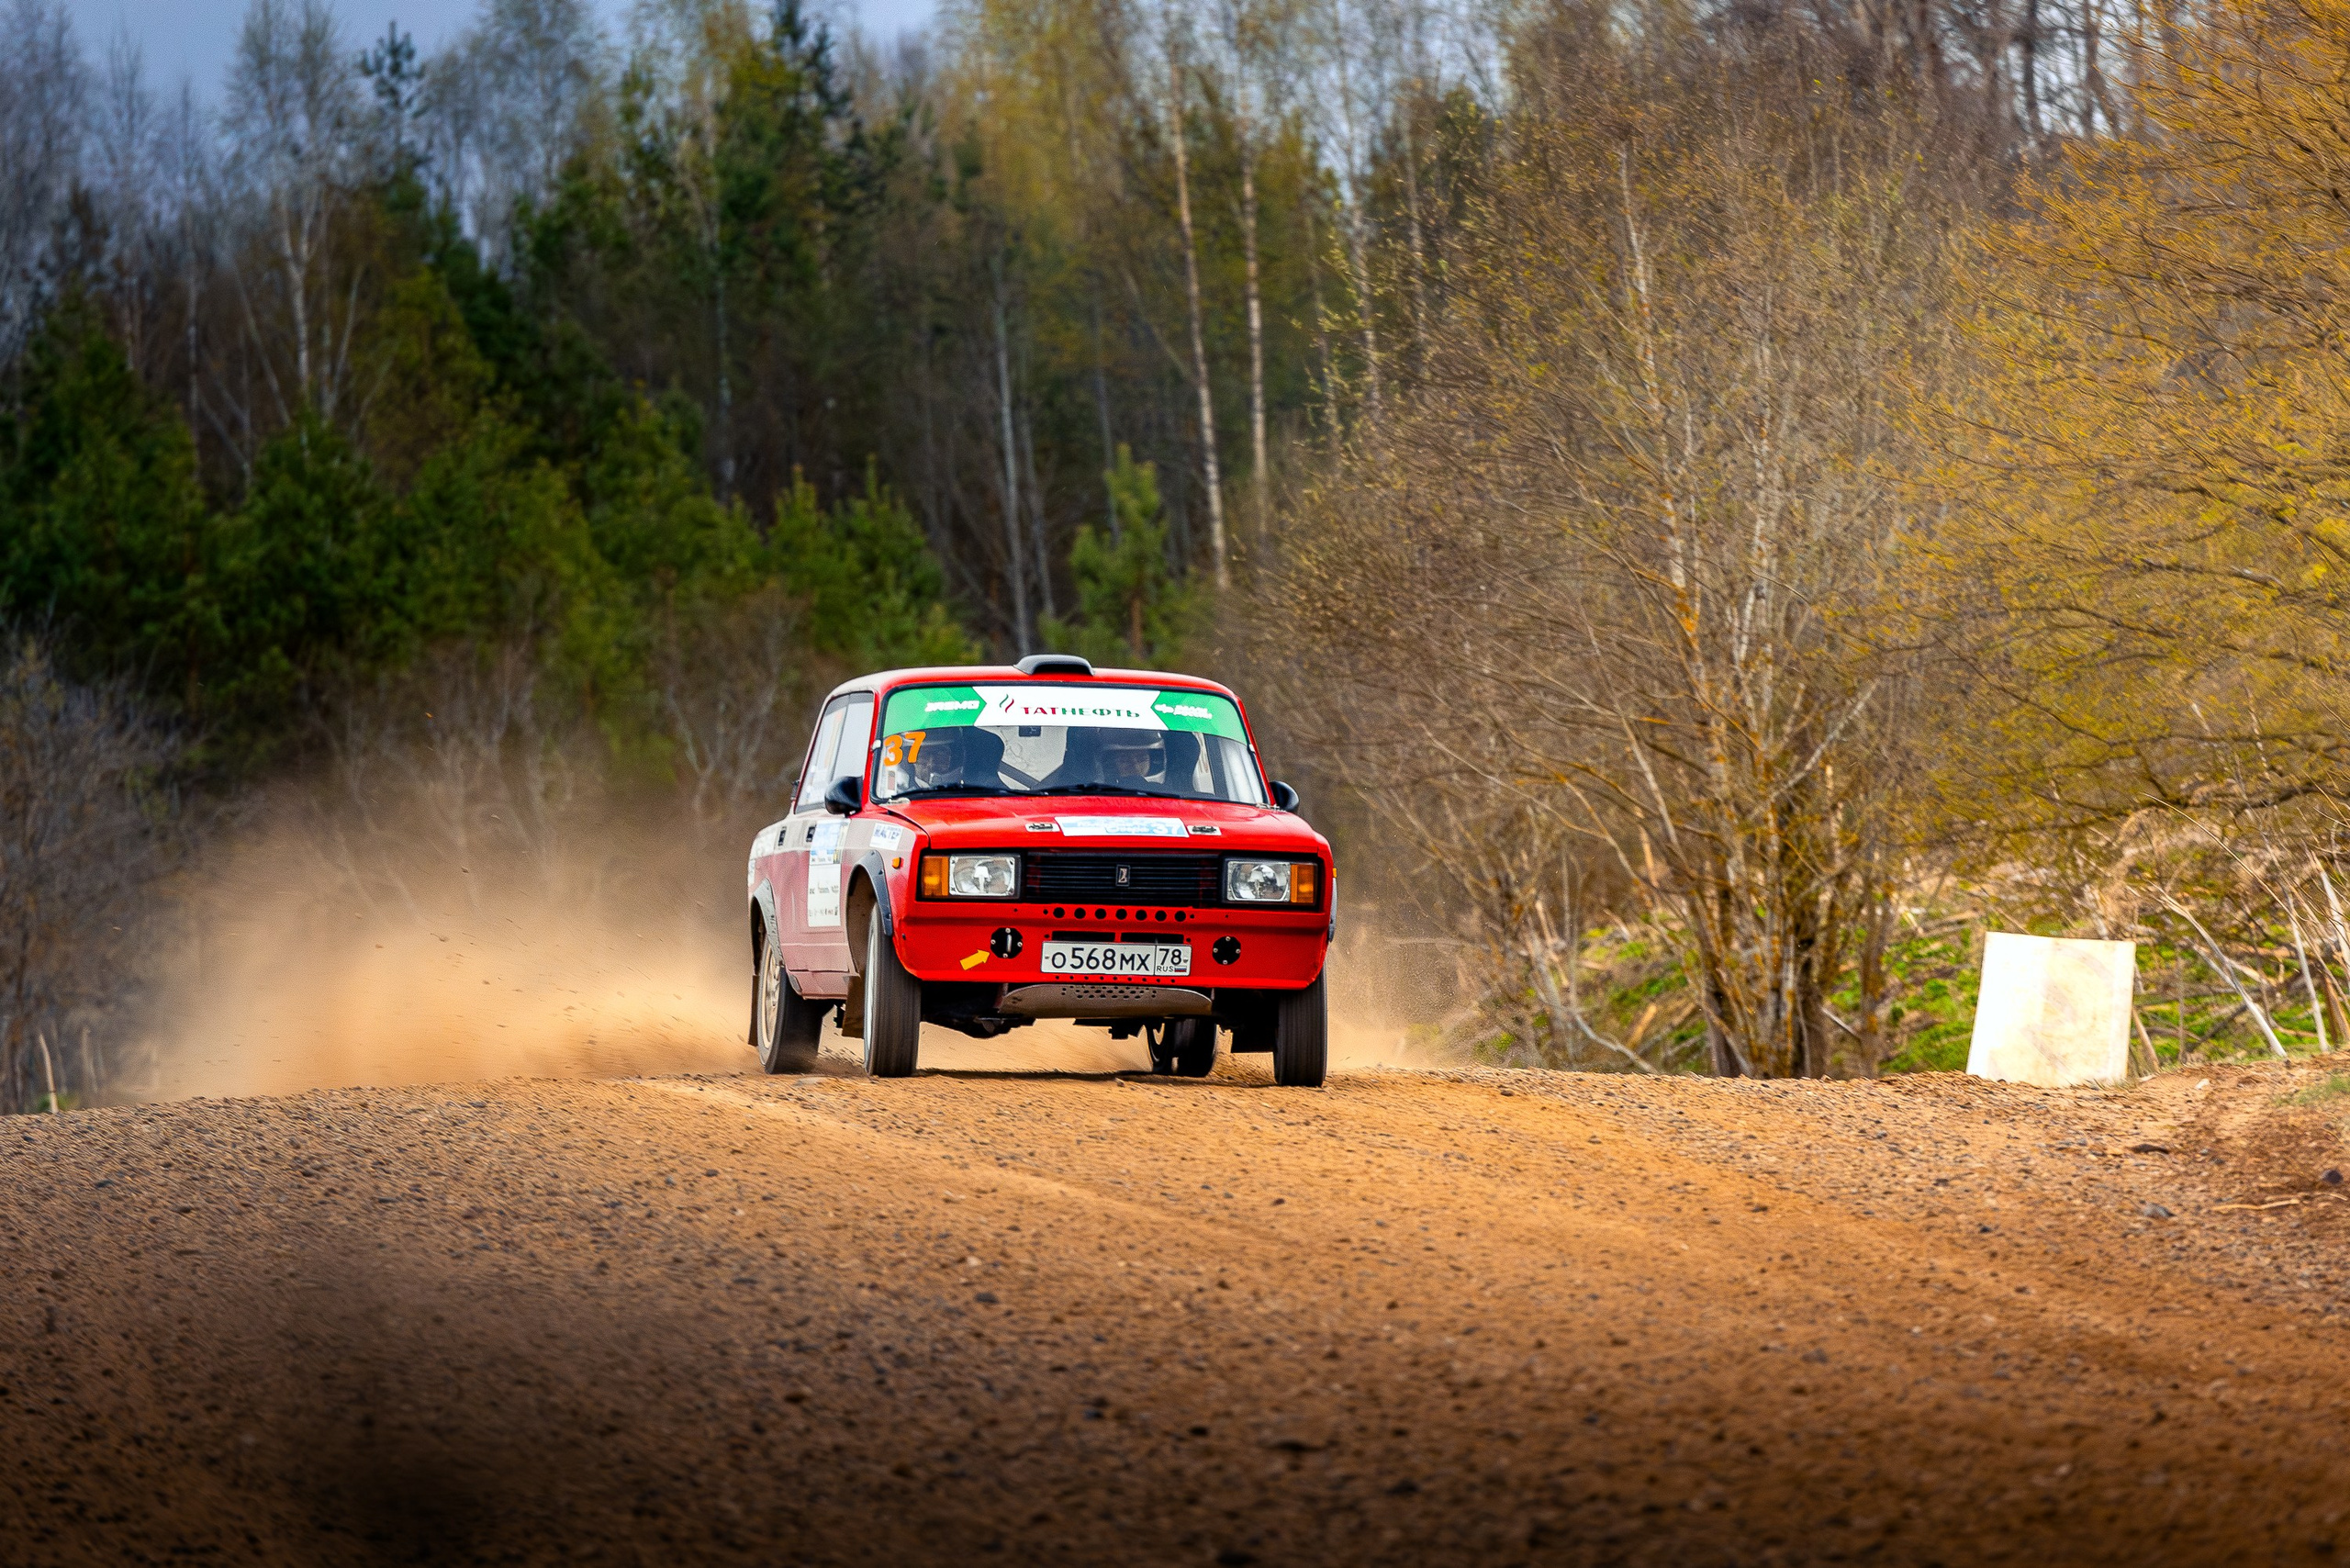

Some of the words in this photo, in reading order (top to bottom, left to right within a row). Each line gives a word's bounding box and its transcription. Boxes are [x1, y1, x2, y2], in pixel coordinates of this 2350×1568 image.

[1021, 706, 1140, 718] ТАТНЕФТЬ
[883, 731, 927, 767] 37
[1051, 947, 1150, 971] О568МХ
[1158, 947, 1182, 966] 78
[1156, 965, 1174, 973] RUS
